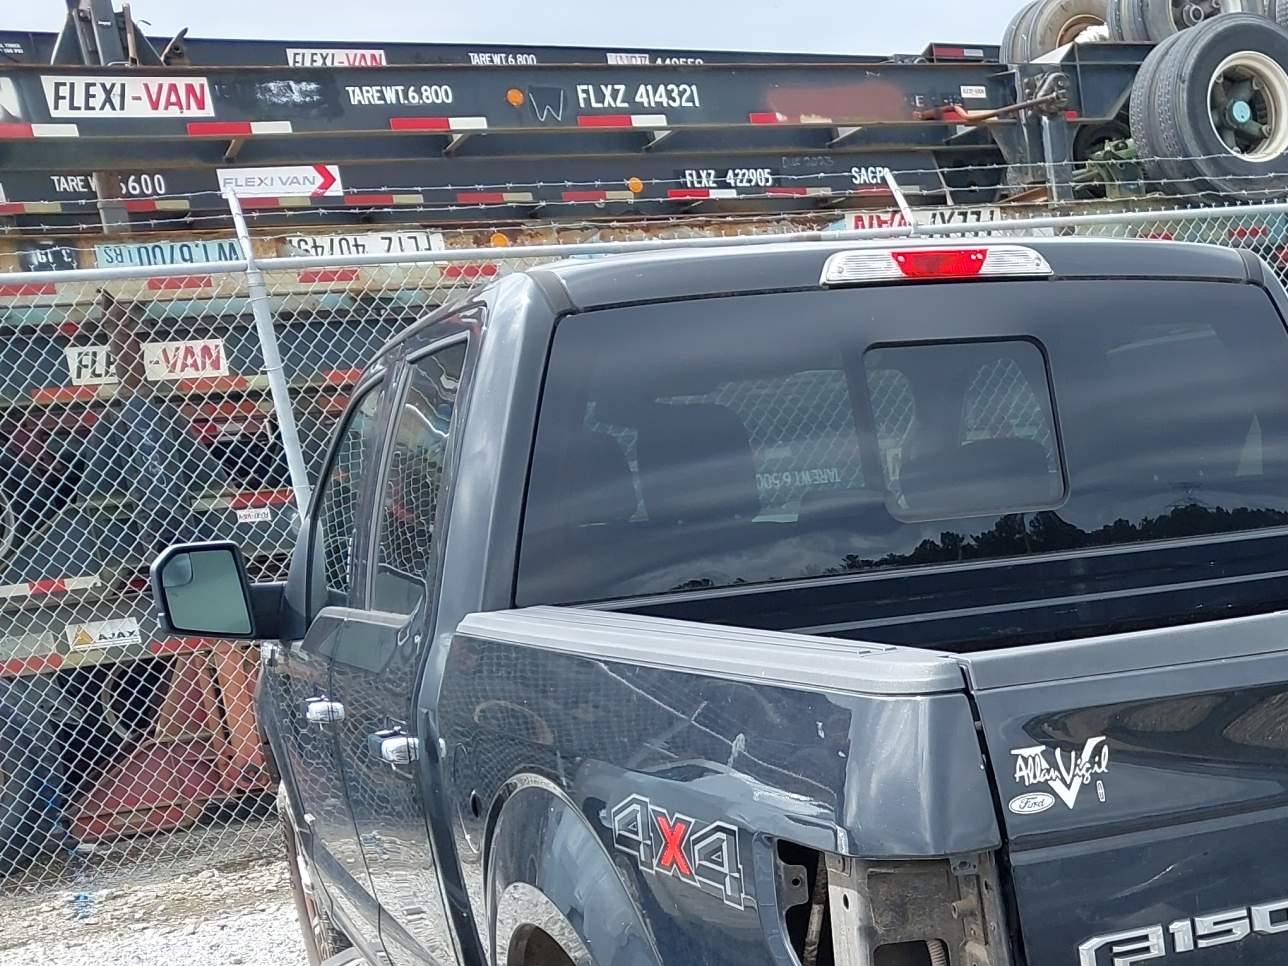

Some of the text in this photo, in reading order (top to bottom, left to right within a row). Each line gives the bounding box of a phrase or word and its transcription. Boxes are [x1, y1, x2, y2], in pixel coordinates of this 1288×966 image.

[53, 82, 206, 111] FLEXI-VAN
[576, 84, 701, 108] FLXZ 414321
[51, 175, 88, 193] TARE
[684, 168, 773, 188] FLXZ 422905
[1014, 743, 1109, 787] Allan Vigil
